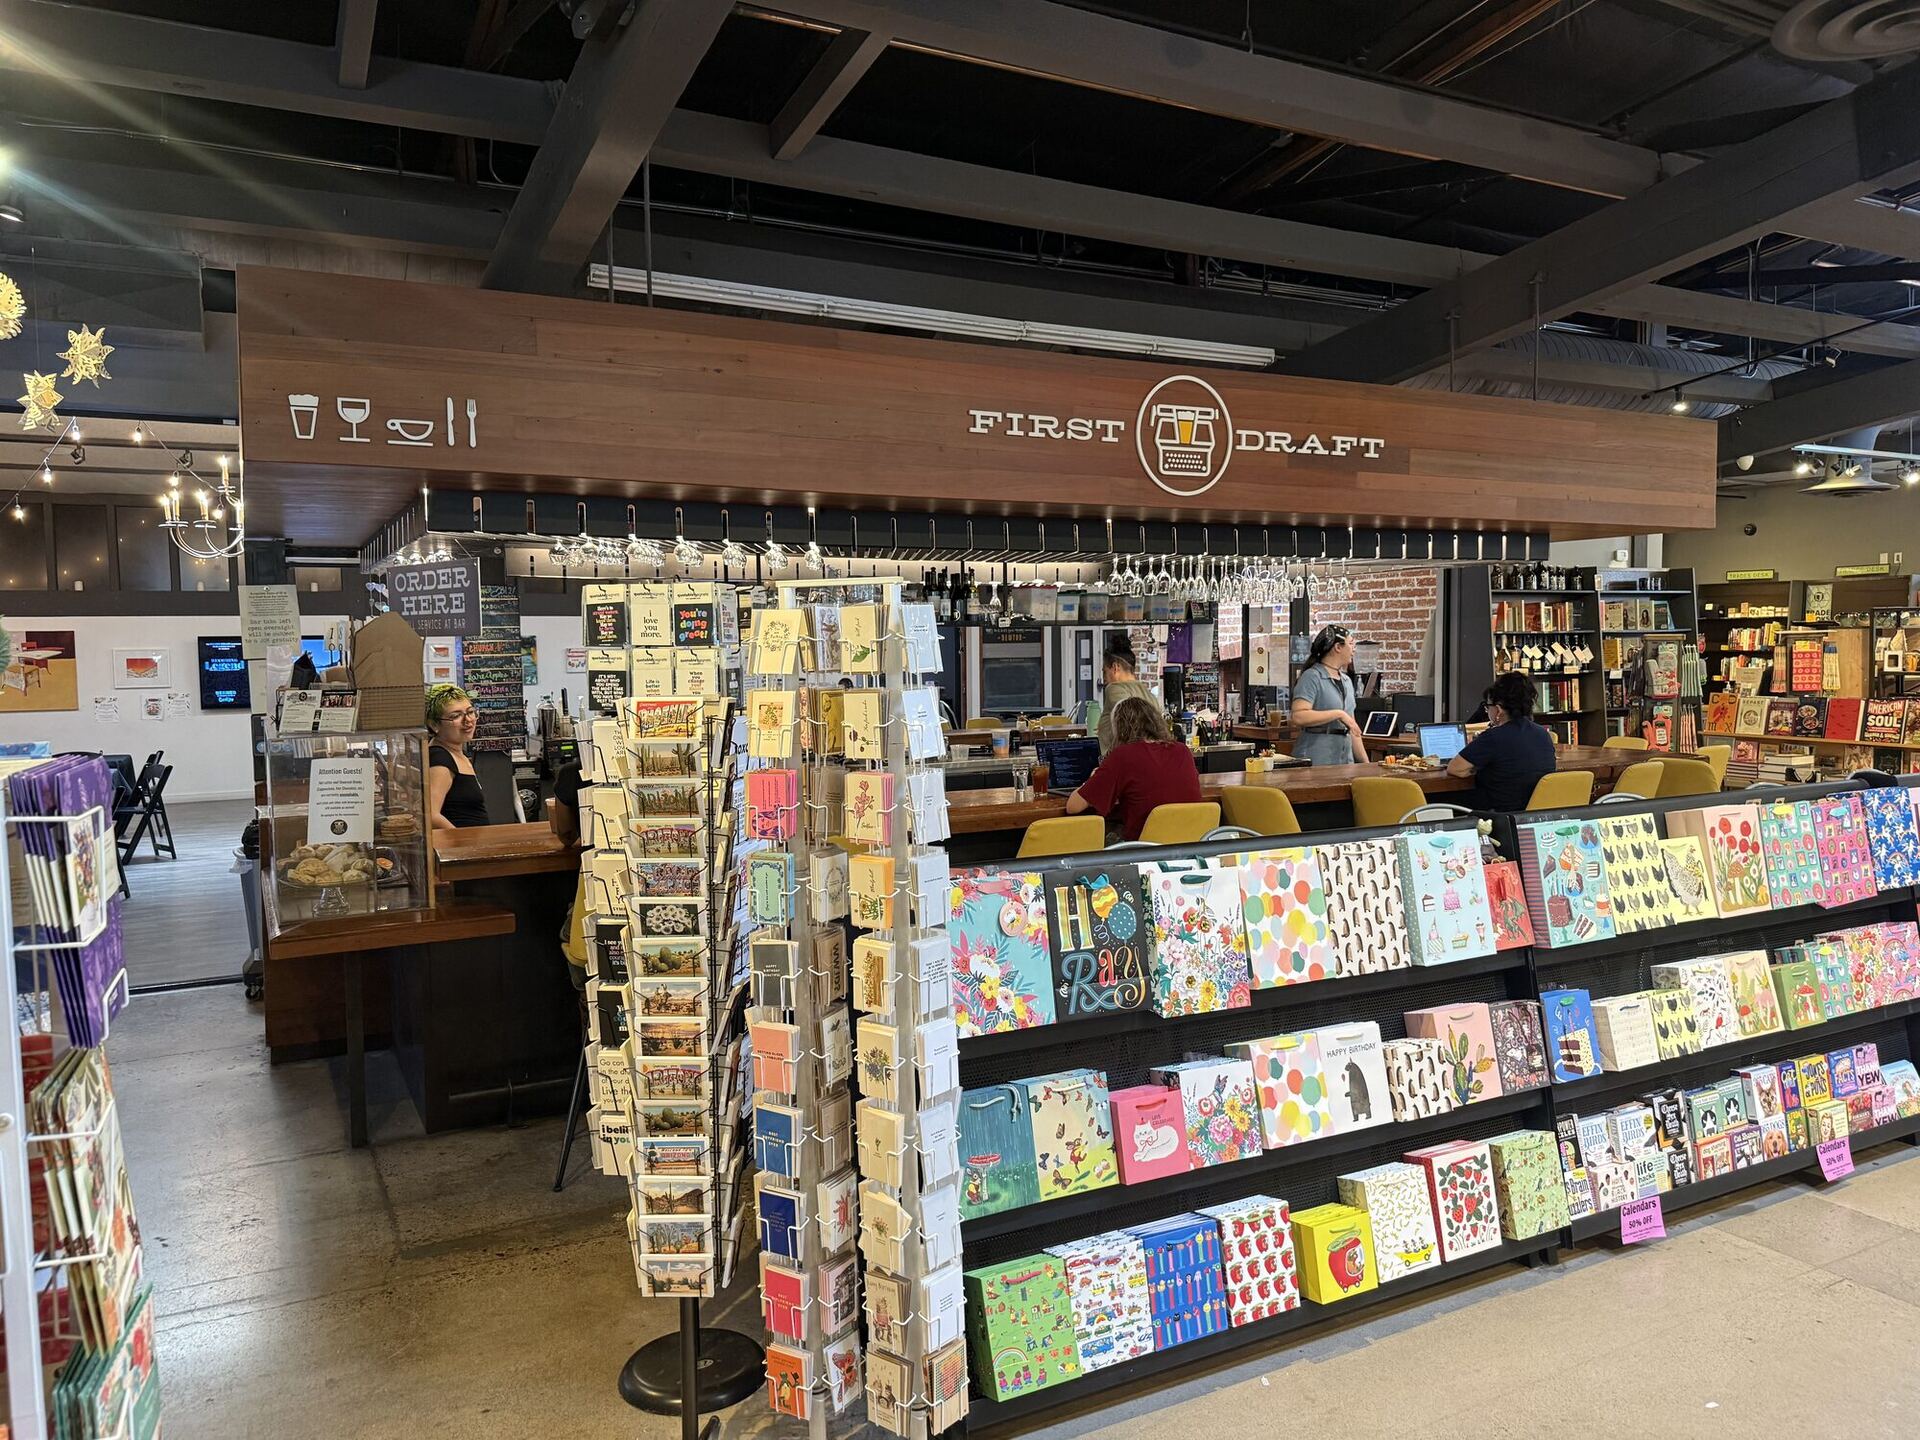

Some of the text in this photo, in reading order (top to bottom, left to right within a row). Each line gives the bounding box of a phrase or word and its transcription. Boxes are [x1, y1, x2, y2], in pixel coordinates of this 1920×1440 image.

[968, 409, 1384, 459] FIRST DRAFT
[394, 566, 470, 592] ORDER
[401, 592, 466, 616] HERE
[643, 616, 658, 624] love
[679, 608, 708, 620] you're
[417, 618, 466, 630] SERVICE AT BAR
[680, 619, 708, 630] doing
[678, 630, 708, 642] great!
[1867, 700, 1905, 715] AMERICAN
[1866, 715, 1901, 728] SOUL
[343, 767, 363, 775] Guests!
[1326, 1042, 1377, 1058] HAPPY BIRTHDAY
[1858, 1070, 1881, 1086] YEW
[1582, 1123, 1604, 1137] EFFIN
[1620, 1117, 1641, 1132] EFFIN
[1583, 1134, 1607, 1150] BIRDS
[1622, 1127, 1645, 1144] BIRDS
[1818, 1138, 1846, 1156] Calendars
[1826, 1153, 1844, 1166] 50% OFF
[1636, 1160, 1654, 1176] life
[1638, 1173, 1655, 1184] hacks
[1569, 1179, 1589, 1195] Brain
[1568, 1198, 1593, 1216] uzzlers
[1622, 1199, 1657, 1217] Calendars
[1629, 1214, 1653, 1228] 50% OFF
